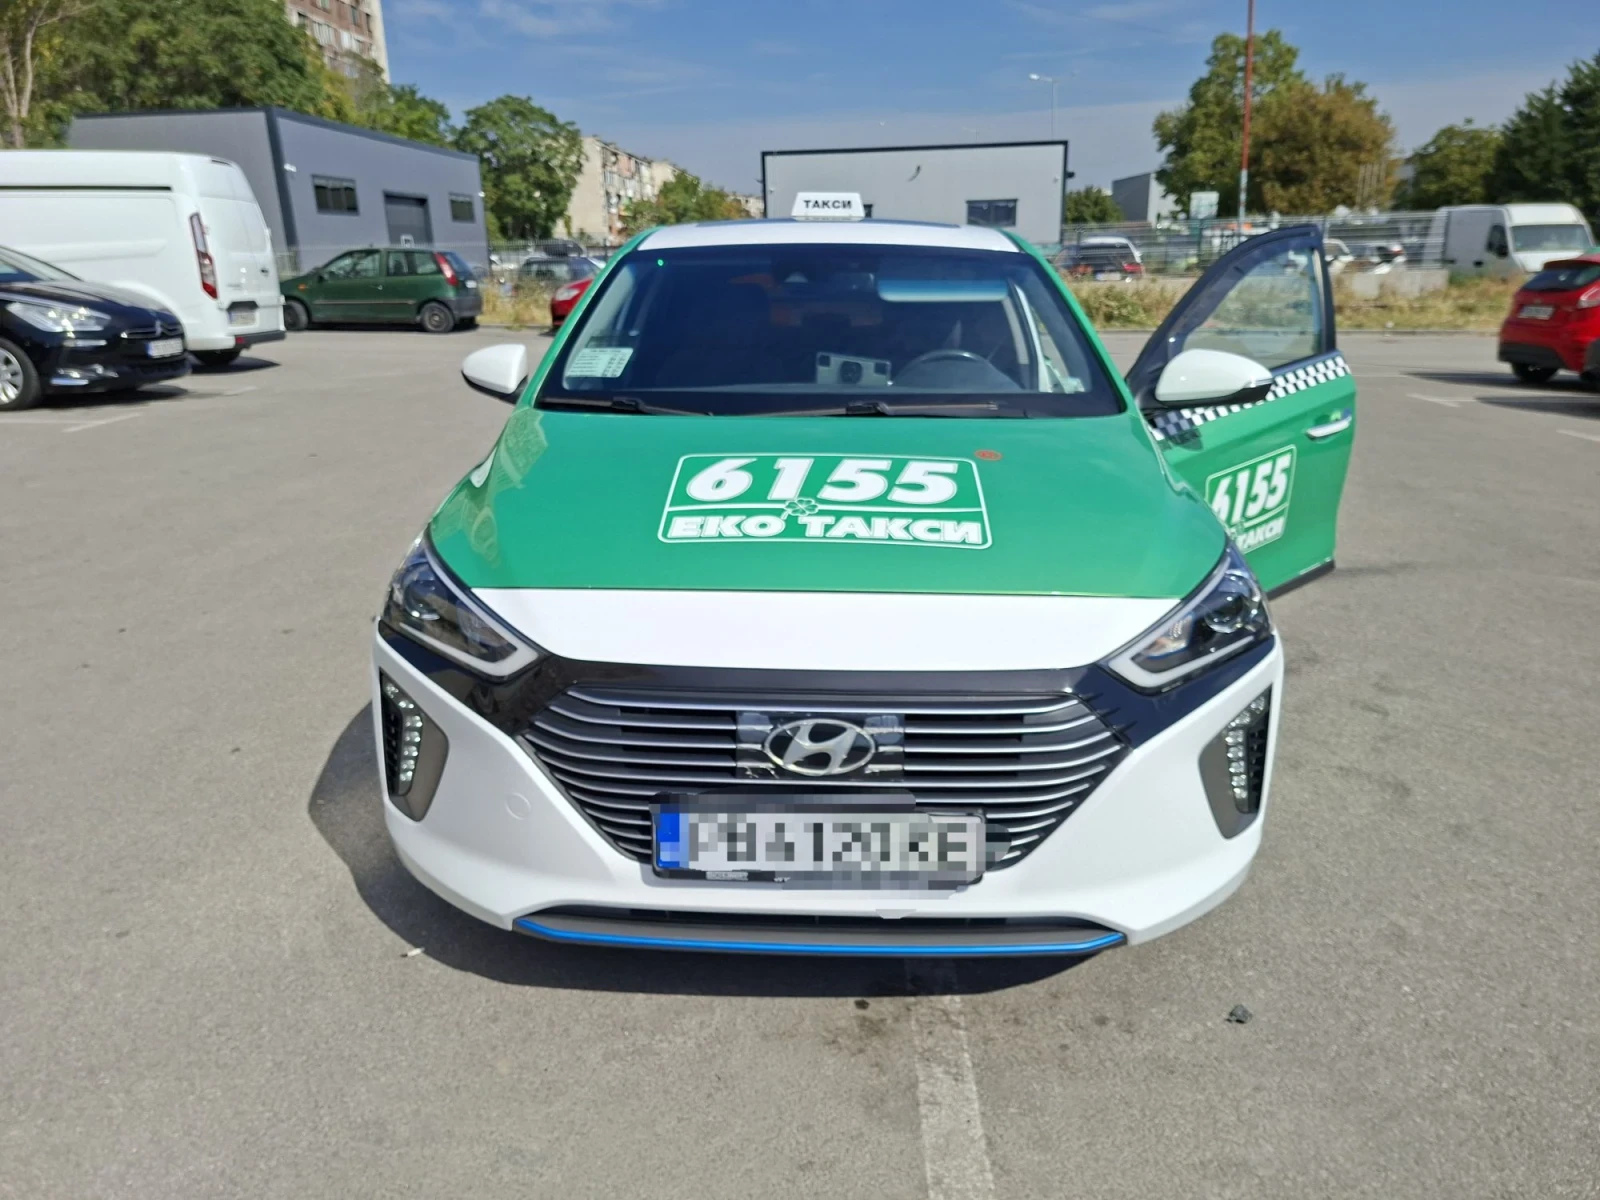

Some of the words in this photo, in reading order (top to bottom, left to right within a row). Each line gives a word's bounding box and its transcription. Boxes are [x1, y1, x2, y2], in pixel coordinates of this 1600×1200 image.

[803, 200, 852, 209] ТАКСИ
[686, 458, 958, 504] 6155
[667, 515, 785, 538] ЕКО
[798, 516, 982, 544] ТАКСИ
